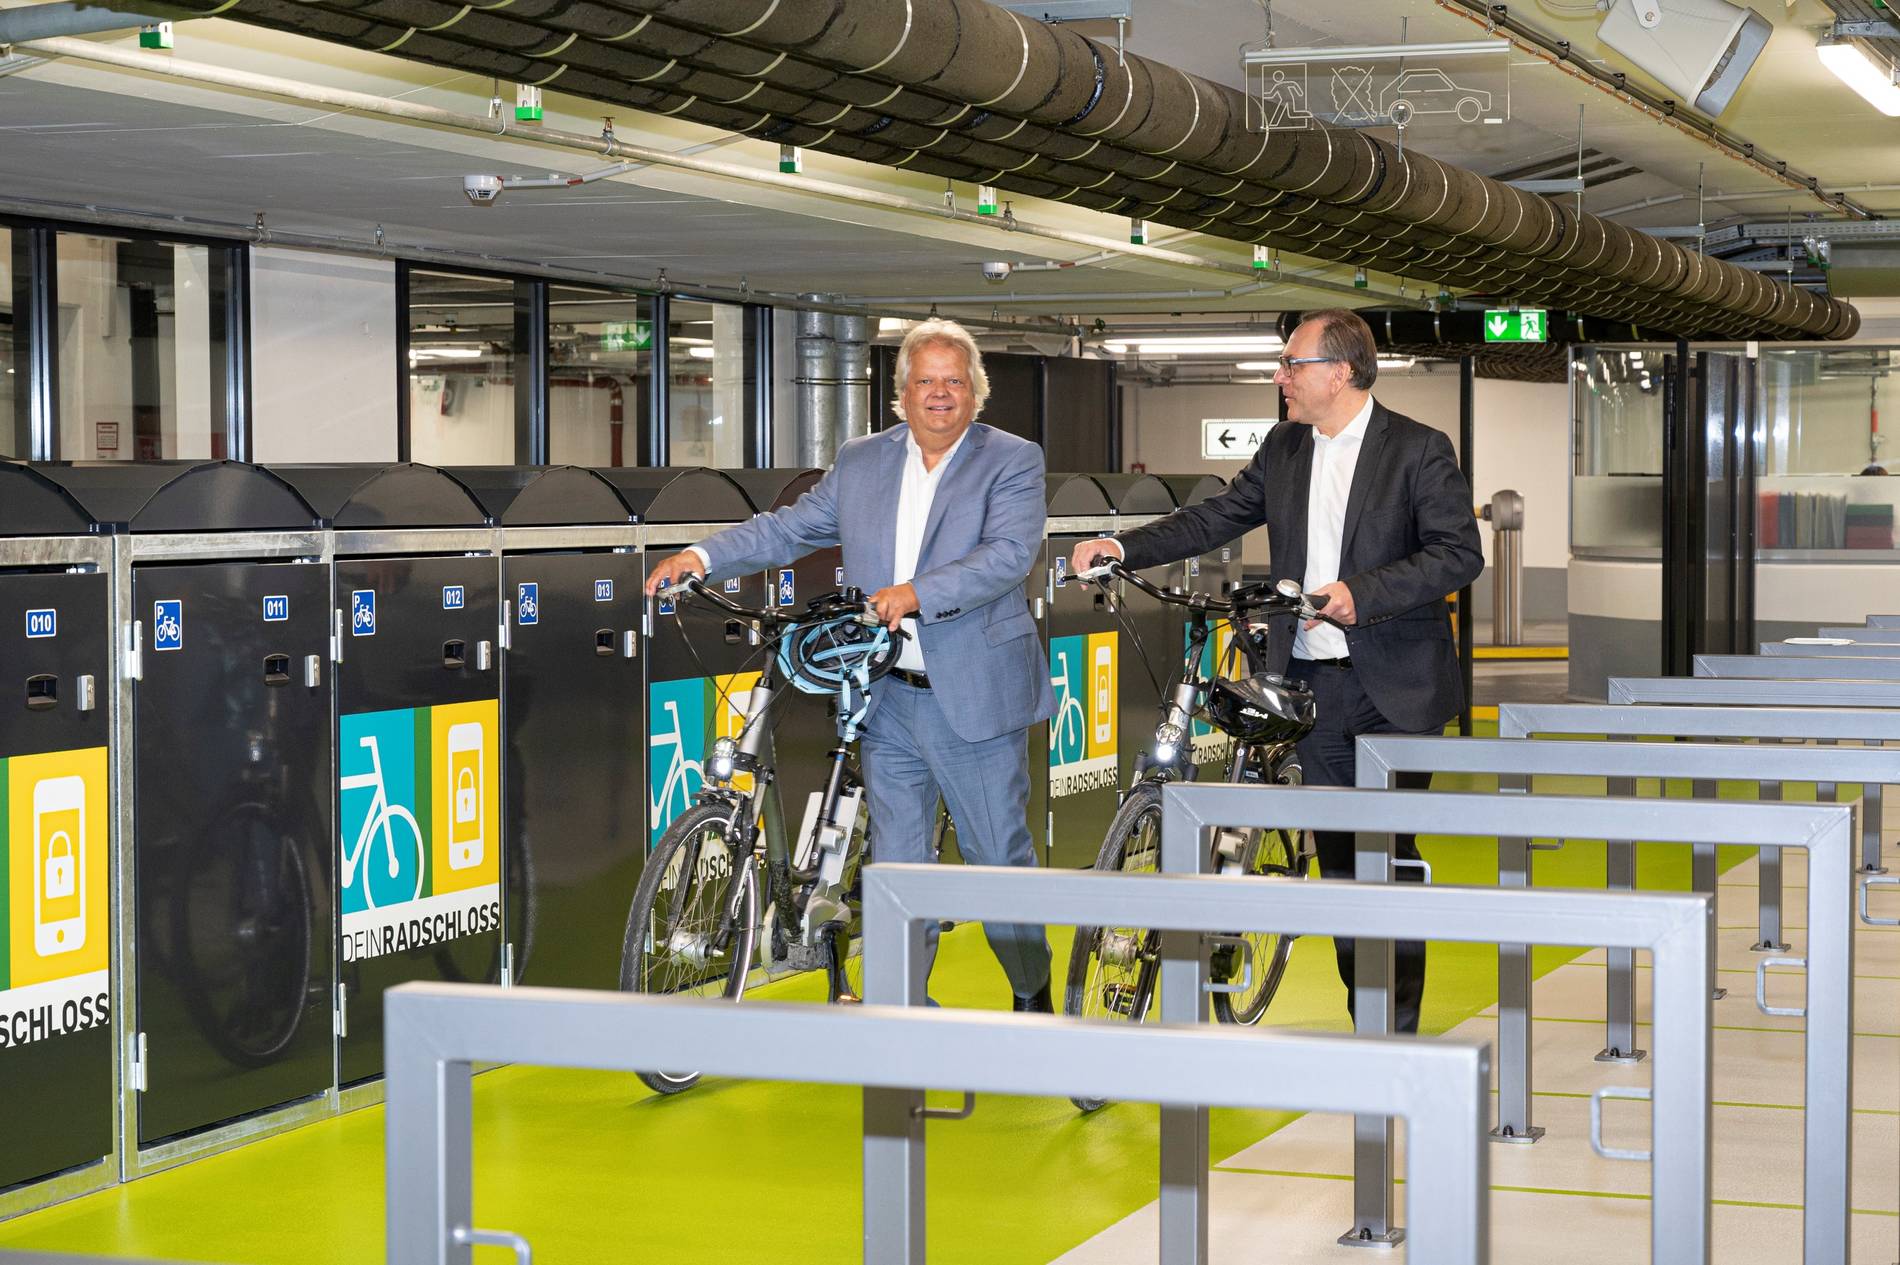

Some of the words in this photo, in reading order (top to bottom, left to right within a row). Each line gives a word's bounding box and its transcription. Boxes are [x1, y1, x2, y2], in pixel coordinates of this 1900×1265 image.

[1248, 432, 1264, 446] A
[445, 590, 461, 605] 012
[520, 587, 526, 599] P
[597, 583, 610, 597] 013
[267, 600, 284, 617] 011
[354, 595, 361, 609] P
[156, 605, 164, 620] P
[31, 615, 52, 633] 010
[1049, 766, 1118, 798] DEINRADSCHLOSS
[342, 901, 500, 962] DEINRADSCHLOSS
